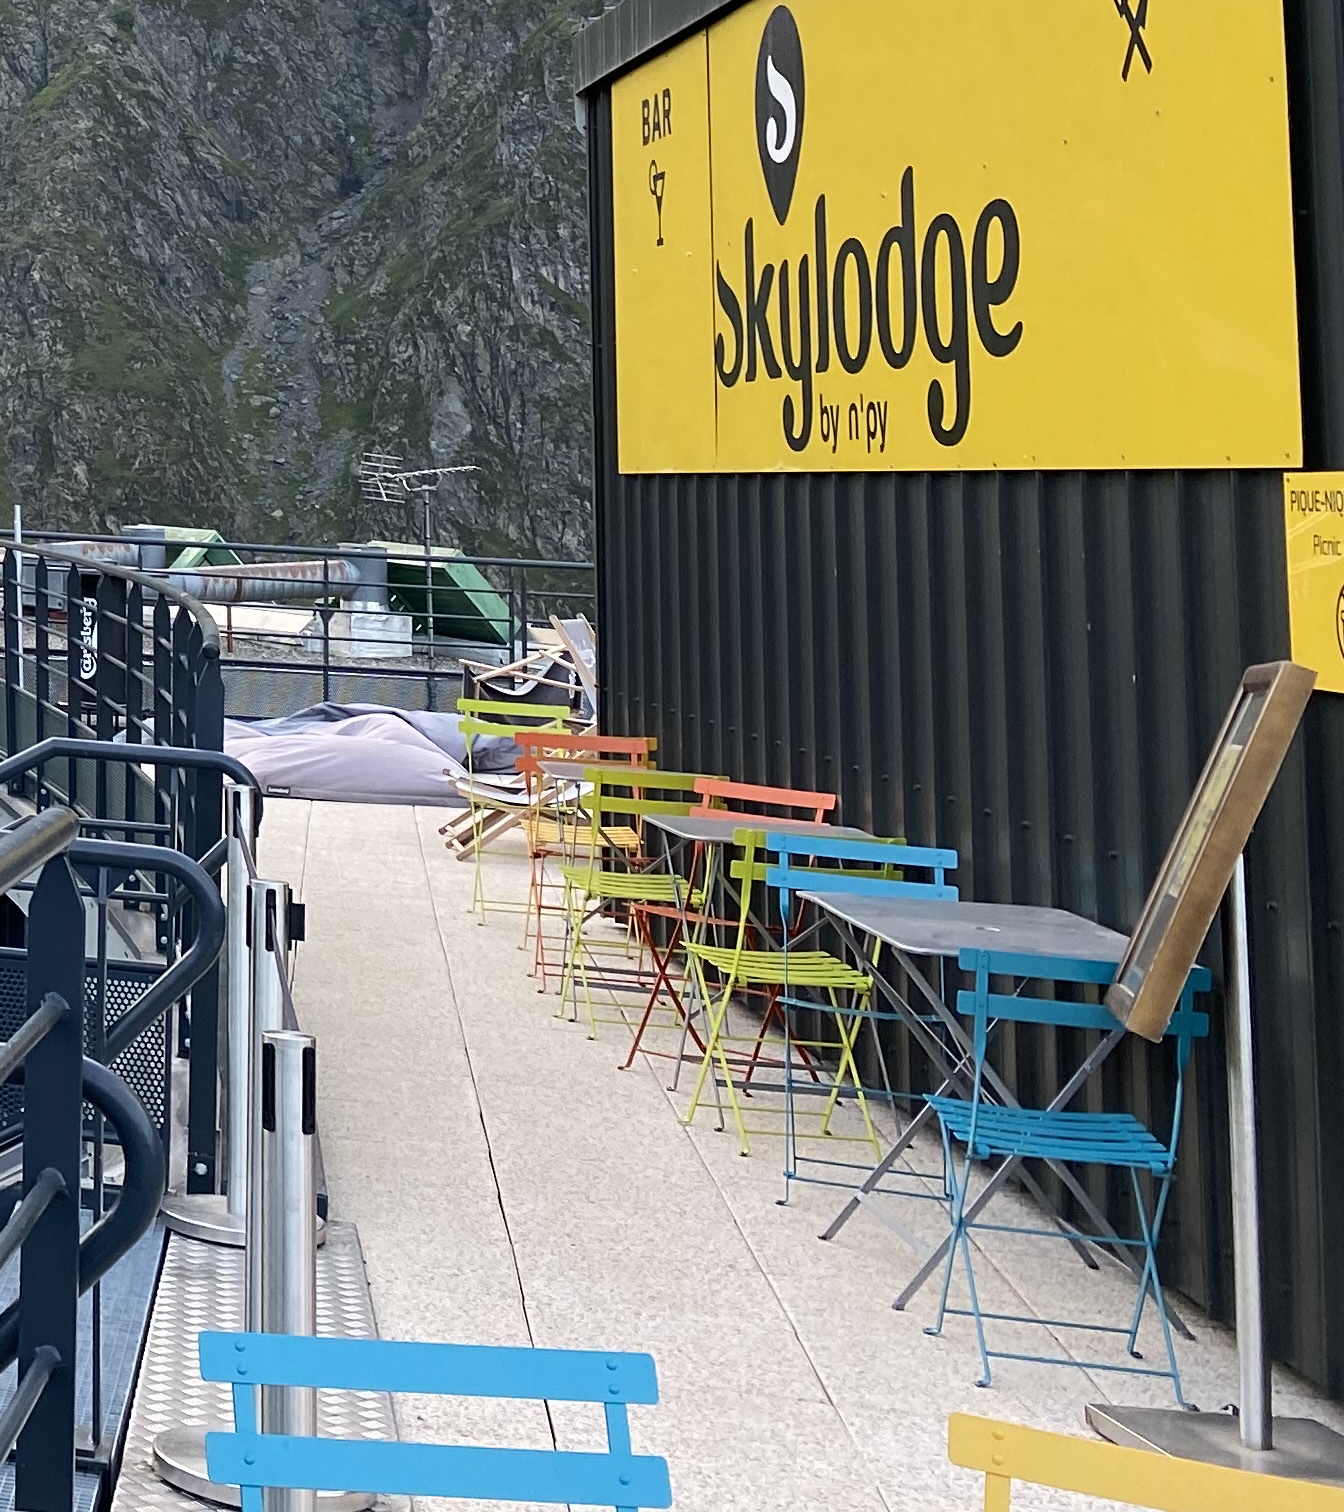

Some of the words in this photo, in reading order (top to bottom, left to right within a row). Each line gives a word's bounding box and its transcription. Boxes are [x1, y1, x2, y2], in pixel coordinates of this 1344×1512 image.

[641, 87, 672, 147] BAR
[819, 393, 840, 454] by
[848, 392, 888, 454] n'py
[1290, 490, 1344, 517] PIQUE-NIQ
[1313, 534, 1342, 556] Picnic
